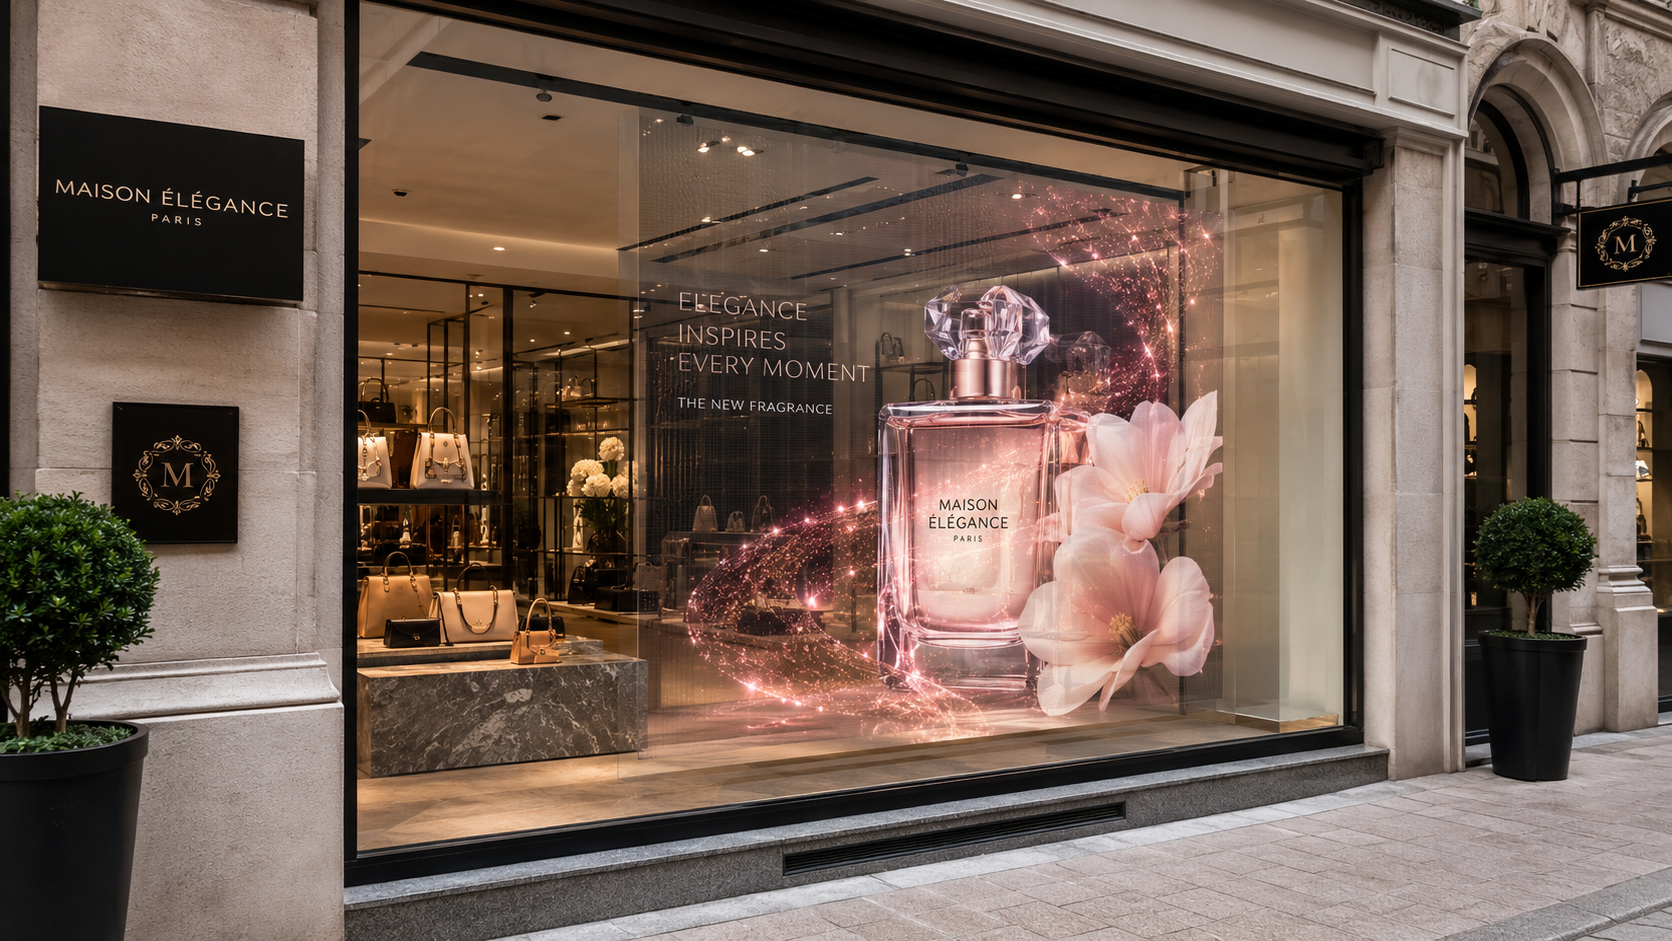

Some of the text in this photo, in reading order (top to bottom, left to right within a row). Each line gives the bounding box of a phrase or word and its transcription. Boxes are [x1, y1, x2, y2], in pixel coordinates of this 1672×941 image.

[55, 178, 289, 219] MAISON ÉLÉGANCE
[151, 213, 202, 226] PARIS
[1613, 233, 1638, 255] M
[679, 323, 786, 351] INSPIRES
[678, 352, 871, 382] EVERY MOMENT
[677, 396, 833, 415] THE NEW FRAGRANCE
[160, 461, 194, 488] M
[939, 498, 998, 511] MAISON
[928, 513, 1009, 529] ÉLÉGANCE
